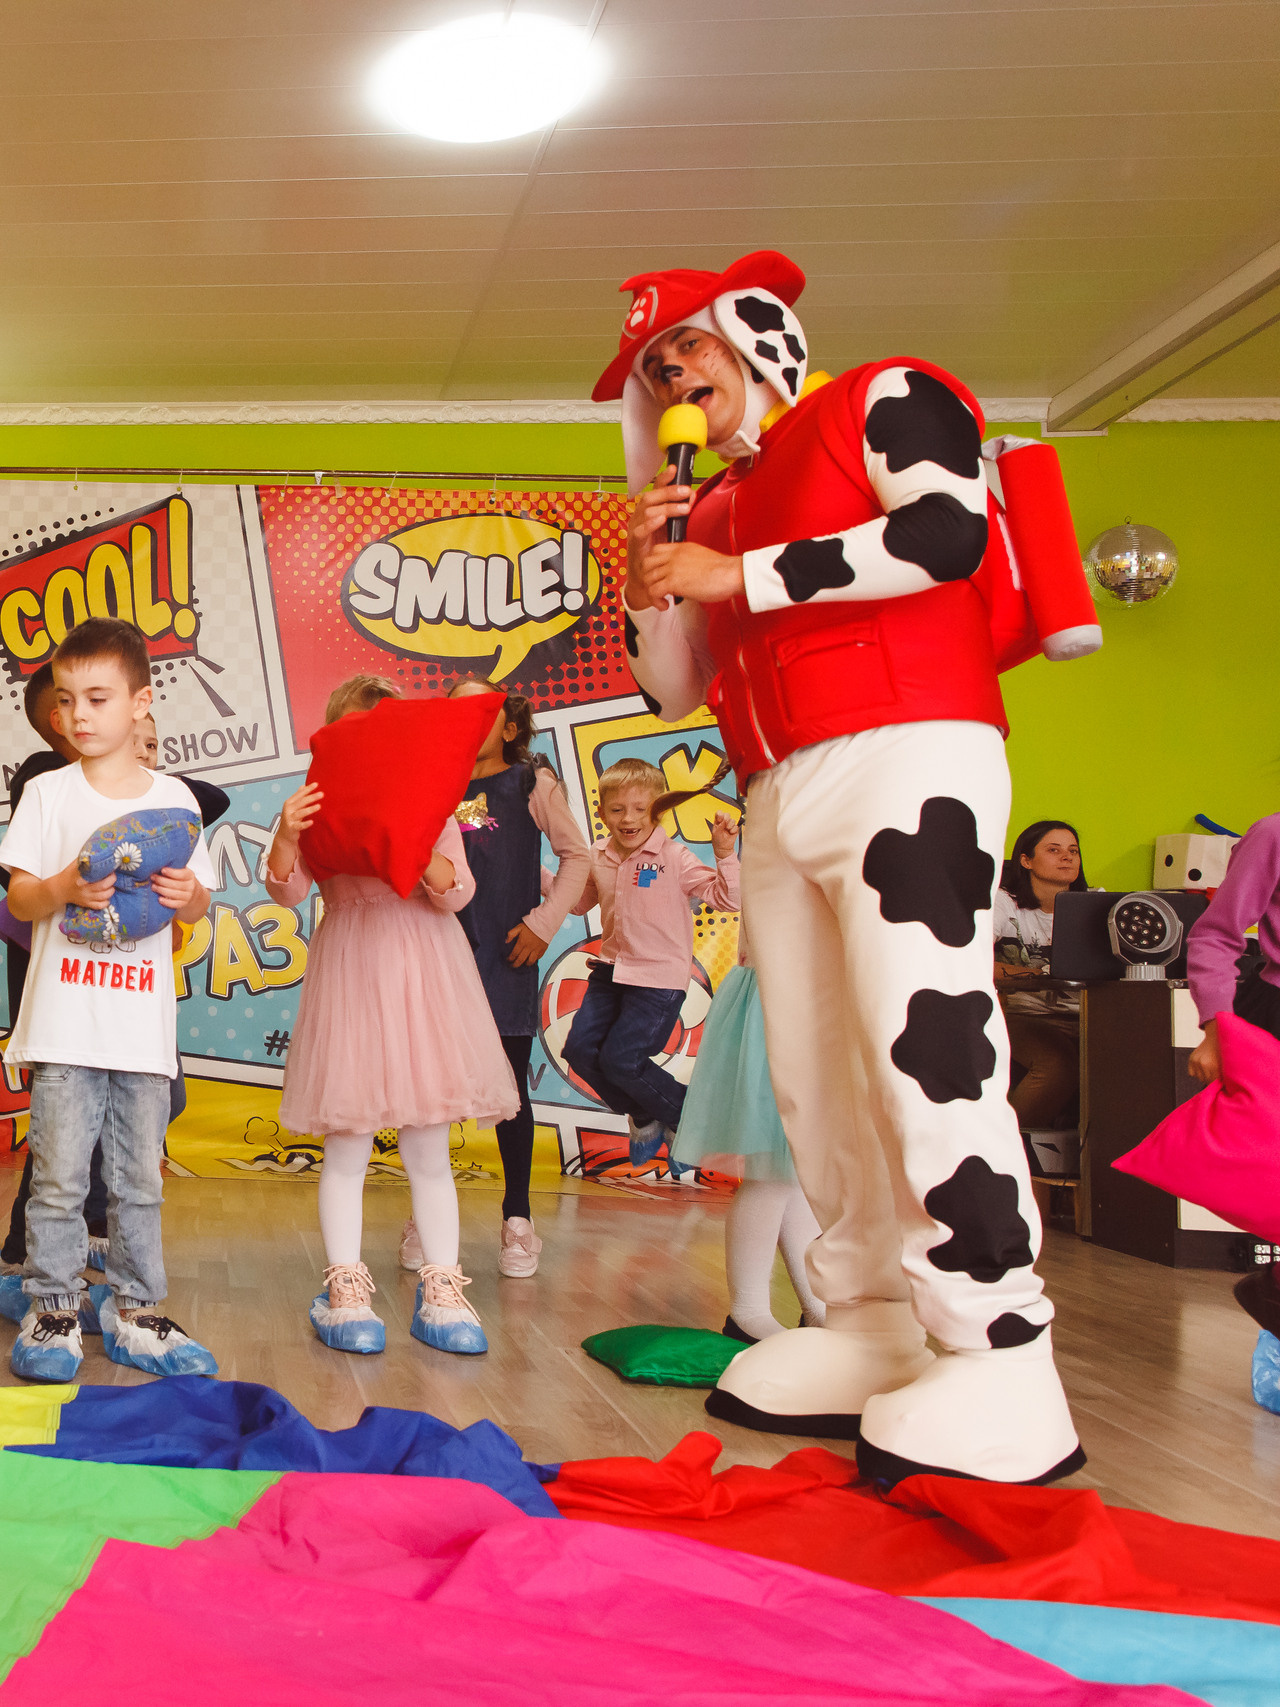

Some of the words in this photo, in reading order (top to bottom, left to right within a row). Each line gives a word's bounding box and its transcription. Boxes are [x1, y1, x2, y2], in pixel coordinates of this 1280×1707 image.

[0, 497, 197, 661] COOL!
[348, 531, 585, 629] SMILE!
[635, 862, 666, 874] LOOK
[60, 957, 155, 993] МАТВЕЙ
[175, 899, 320, 998] РАЗ
